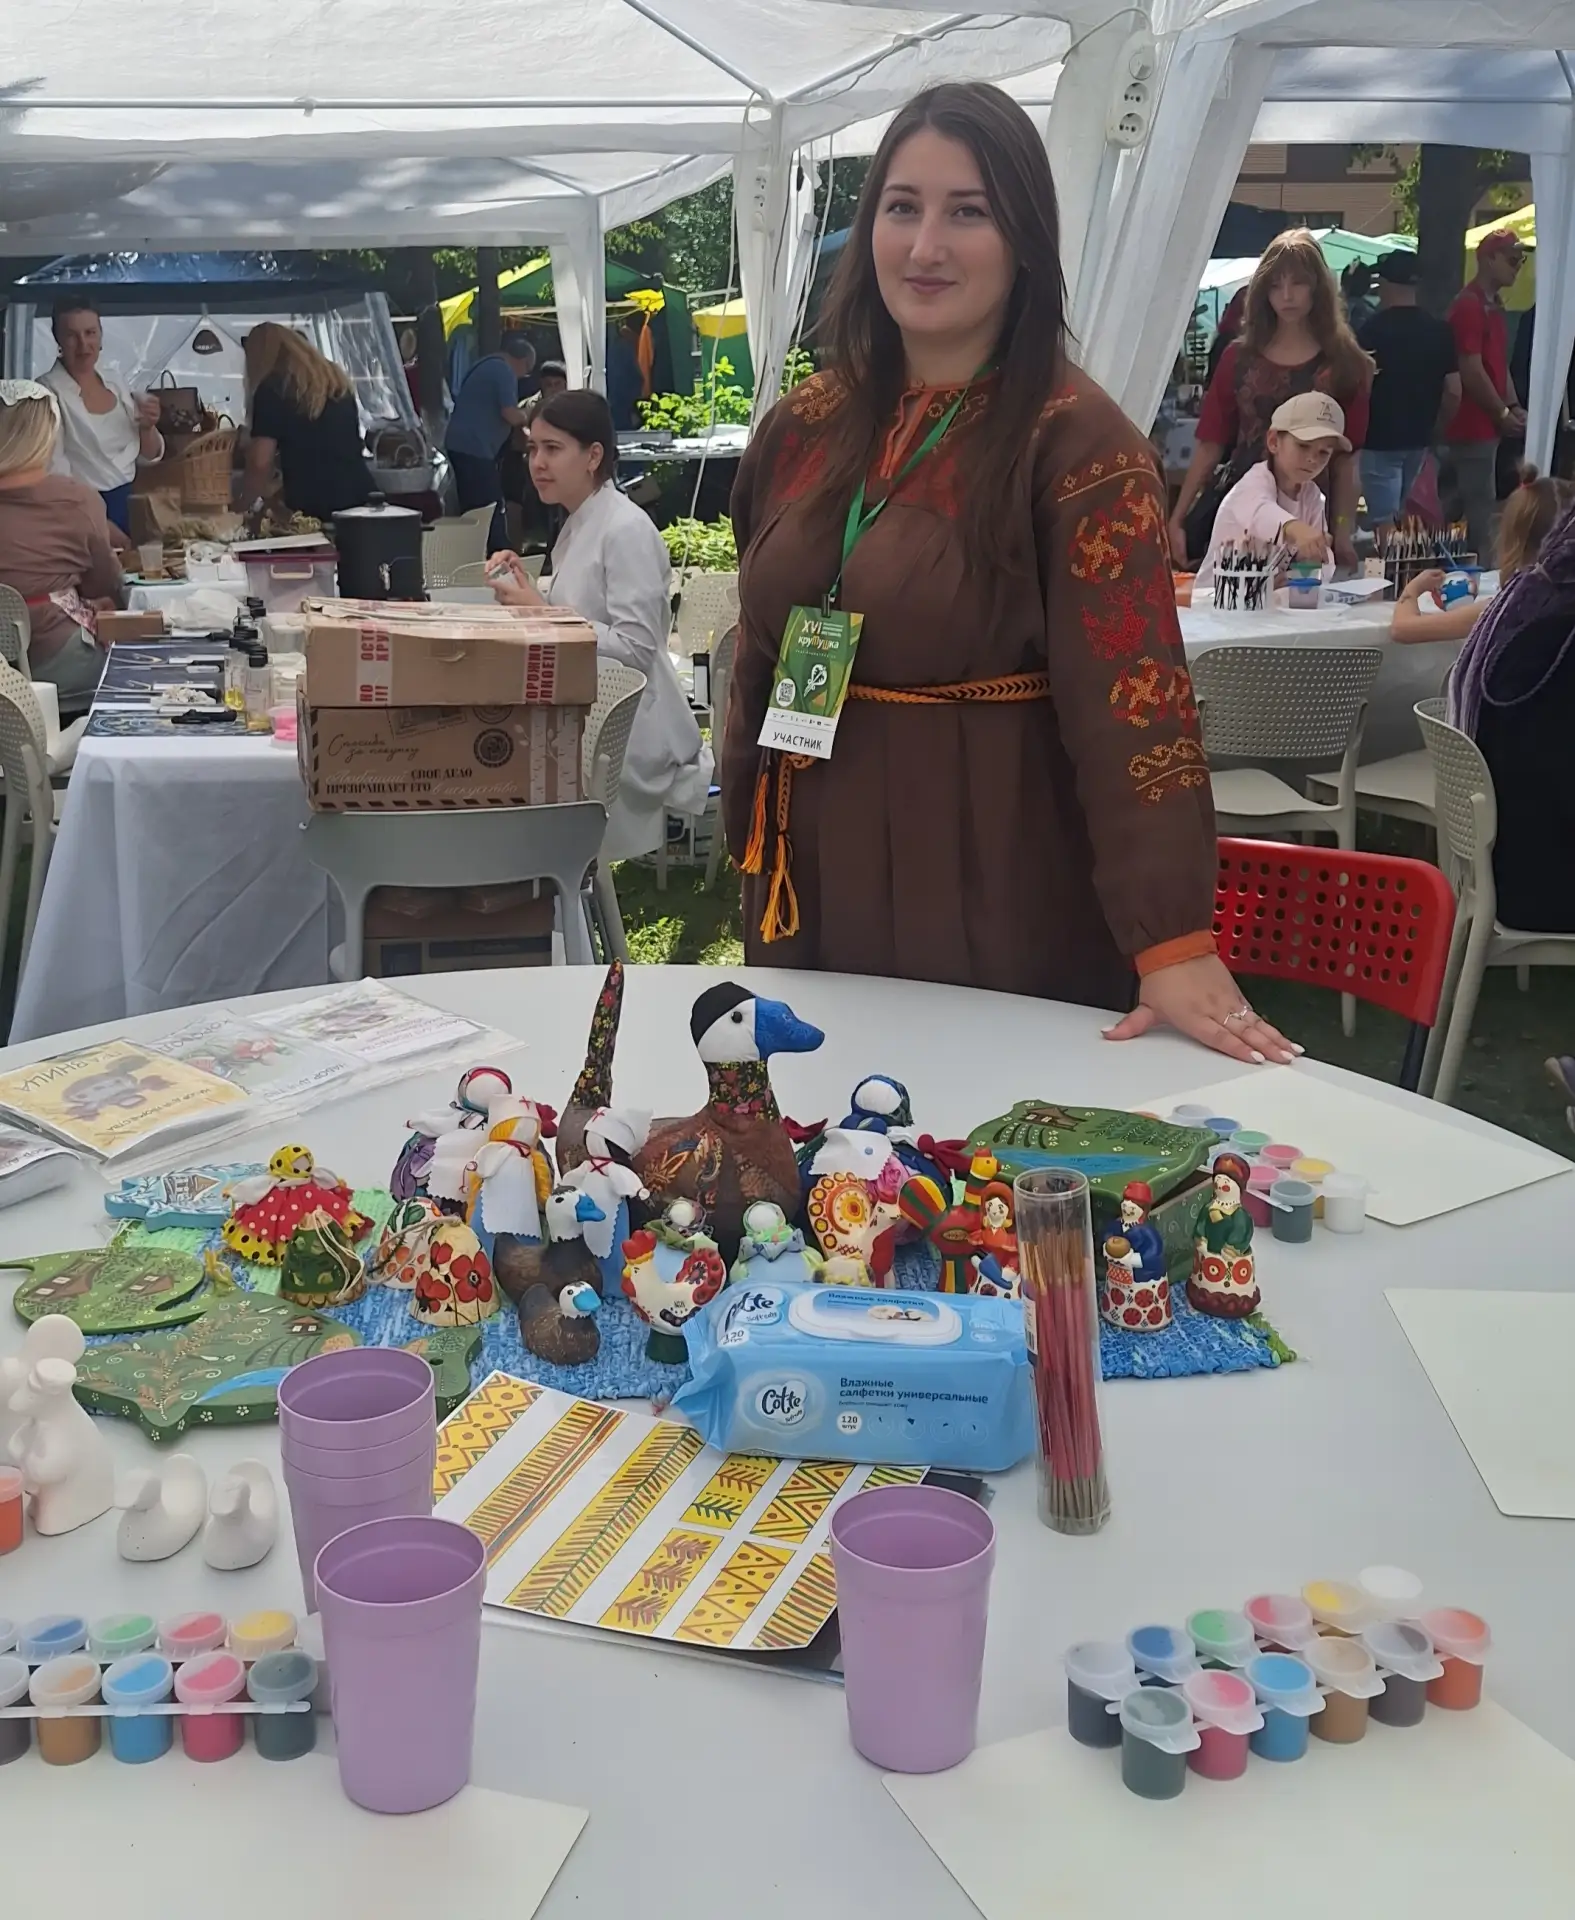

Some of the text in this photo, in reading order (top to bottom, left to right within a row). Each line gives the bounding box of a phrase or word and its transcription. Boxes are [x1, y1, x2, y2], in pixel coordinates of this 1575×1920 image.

[801, 619, 822, 634] XVI
[772, 731, 823, 751] УЧАСТНИК
[840, 1377, 895, 1388] Влажные
[761, 1386, 801, 1415] Cotte
[839, 1387, 895, 1399] салфетки
[897, 1390, 989, 1404] универсальные
[841, 1415, 858, 1424] 120
